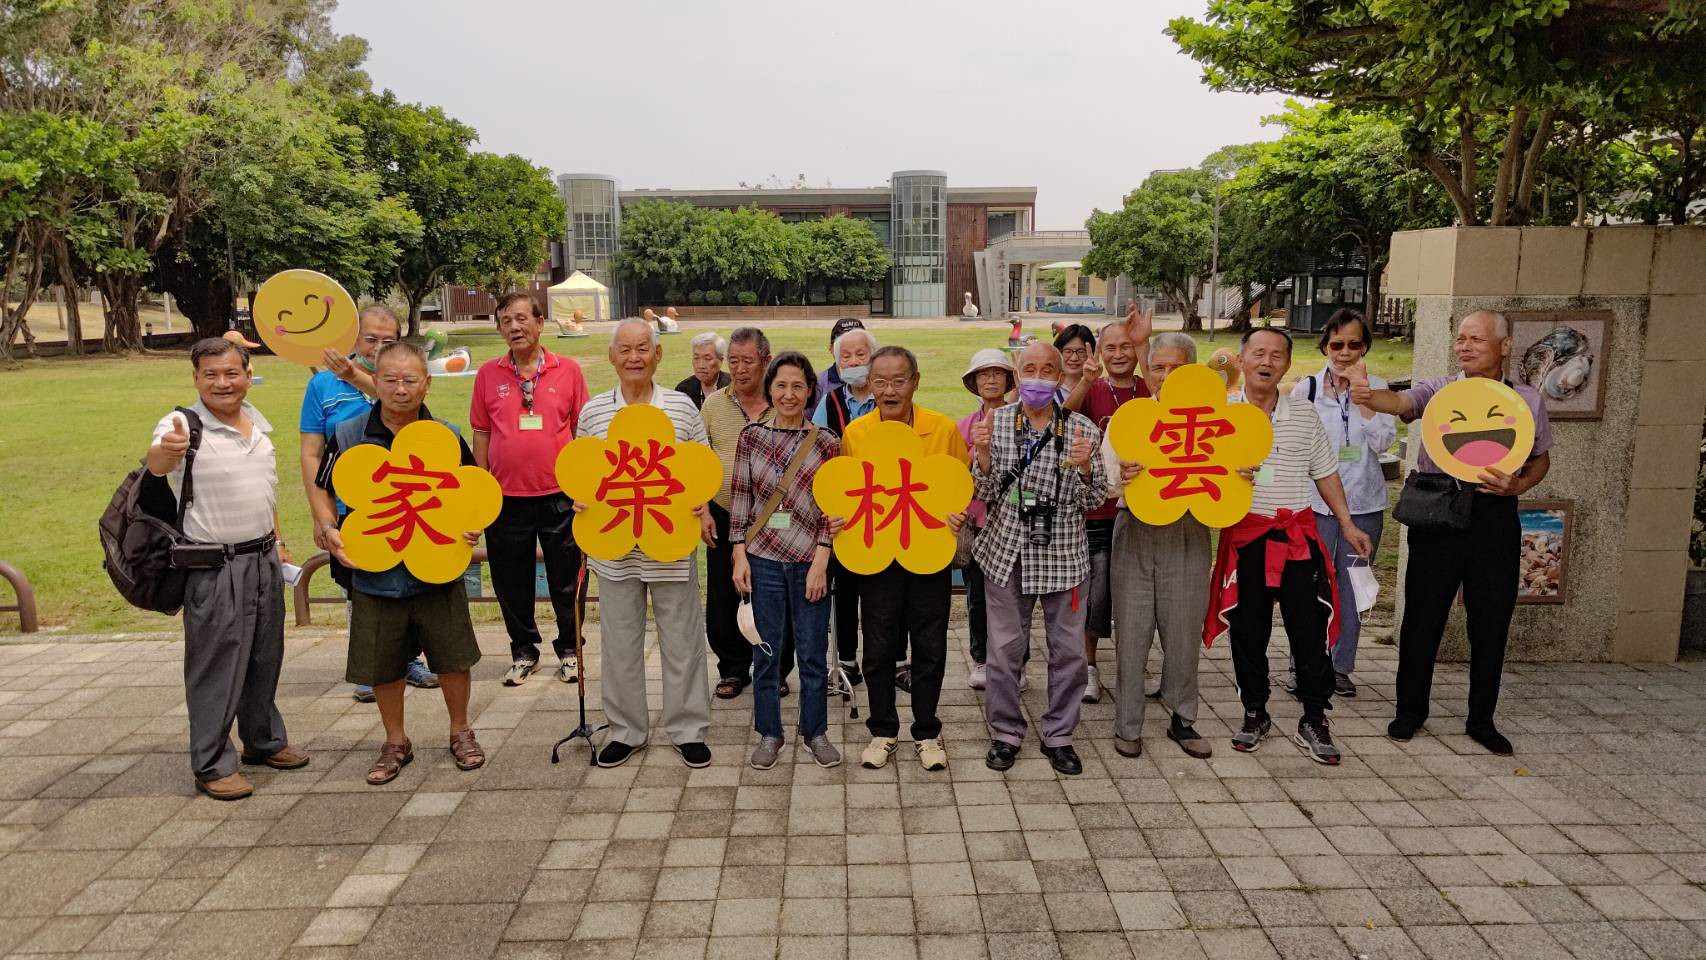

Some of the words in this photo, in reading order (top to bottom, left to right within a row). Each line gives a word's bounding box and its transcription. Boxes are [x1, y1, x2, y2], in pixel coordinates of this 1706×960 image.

[595, 439, 686, 538] 榮
[1148, 406, 1236, 502] 雲
[362, 455, 461, 551] 家
[843, 458, 946, 550] 林
